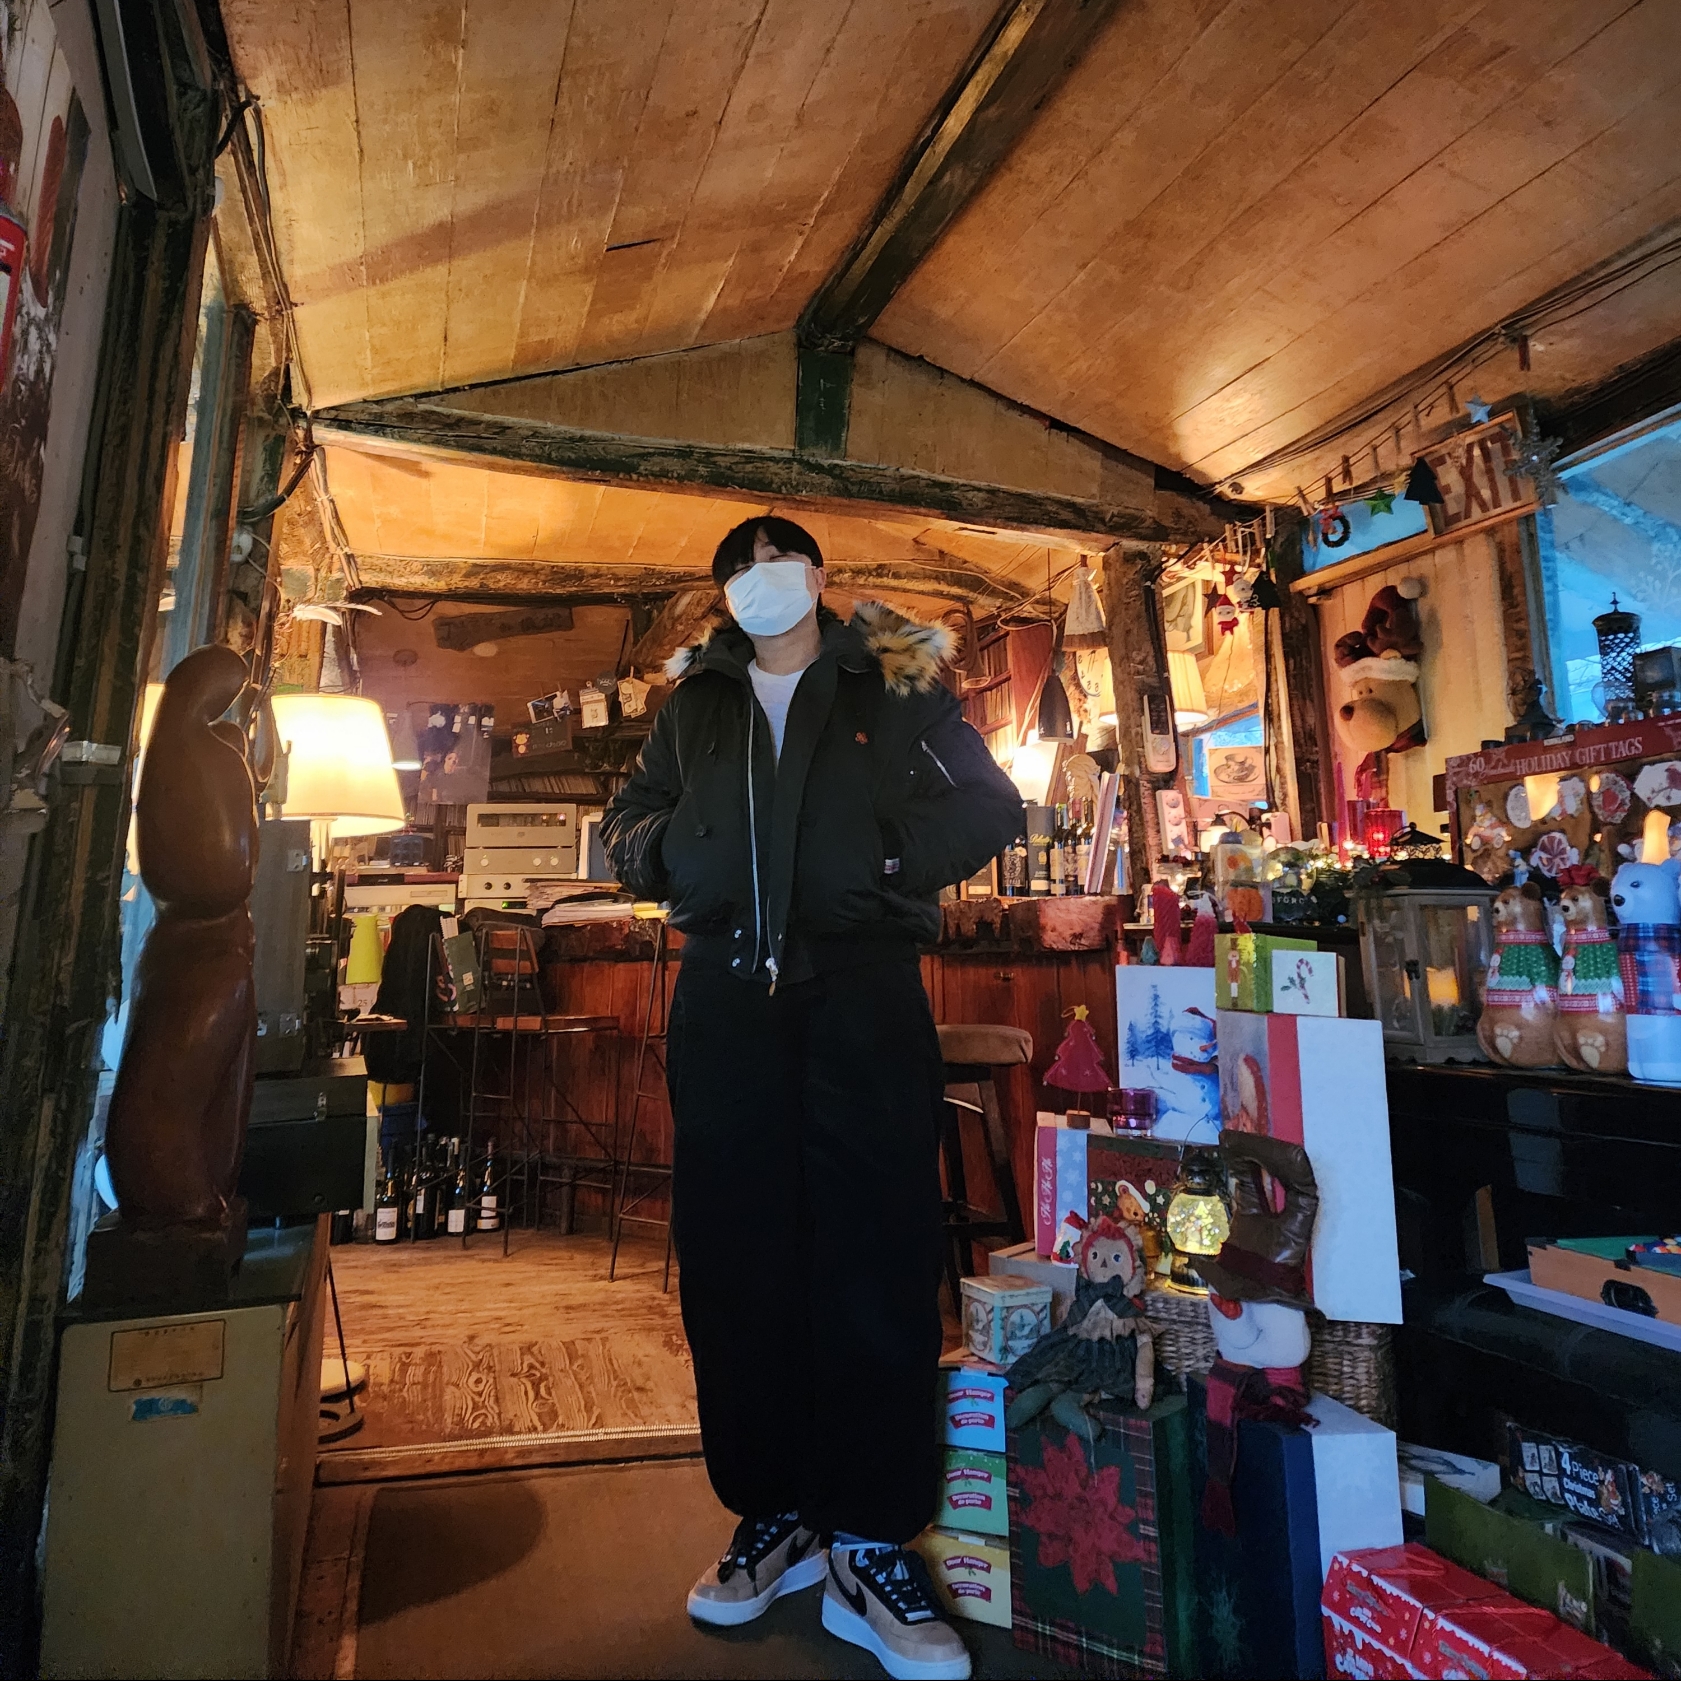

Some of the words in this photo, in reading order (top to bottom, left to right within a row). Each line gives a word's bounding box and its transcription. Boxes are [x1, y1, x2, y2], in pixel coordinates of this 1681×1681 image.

[1429, 430, 1523, 527] EXIT
[1469, 757, 1486, 773] 60
[1515, 750, 1572, 775] HOLIDAY
[1575, 744, 1608, 765] GIFT
[1607, 736, 1643, 759] TAGS
[1561, 1452, 1571, 1475] 4
[1571, 1461, 1600, 1486] Piece
[1564, 1492, 1603, 1521] Plate
